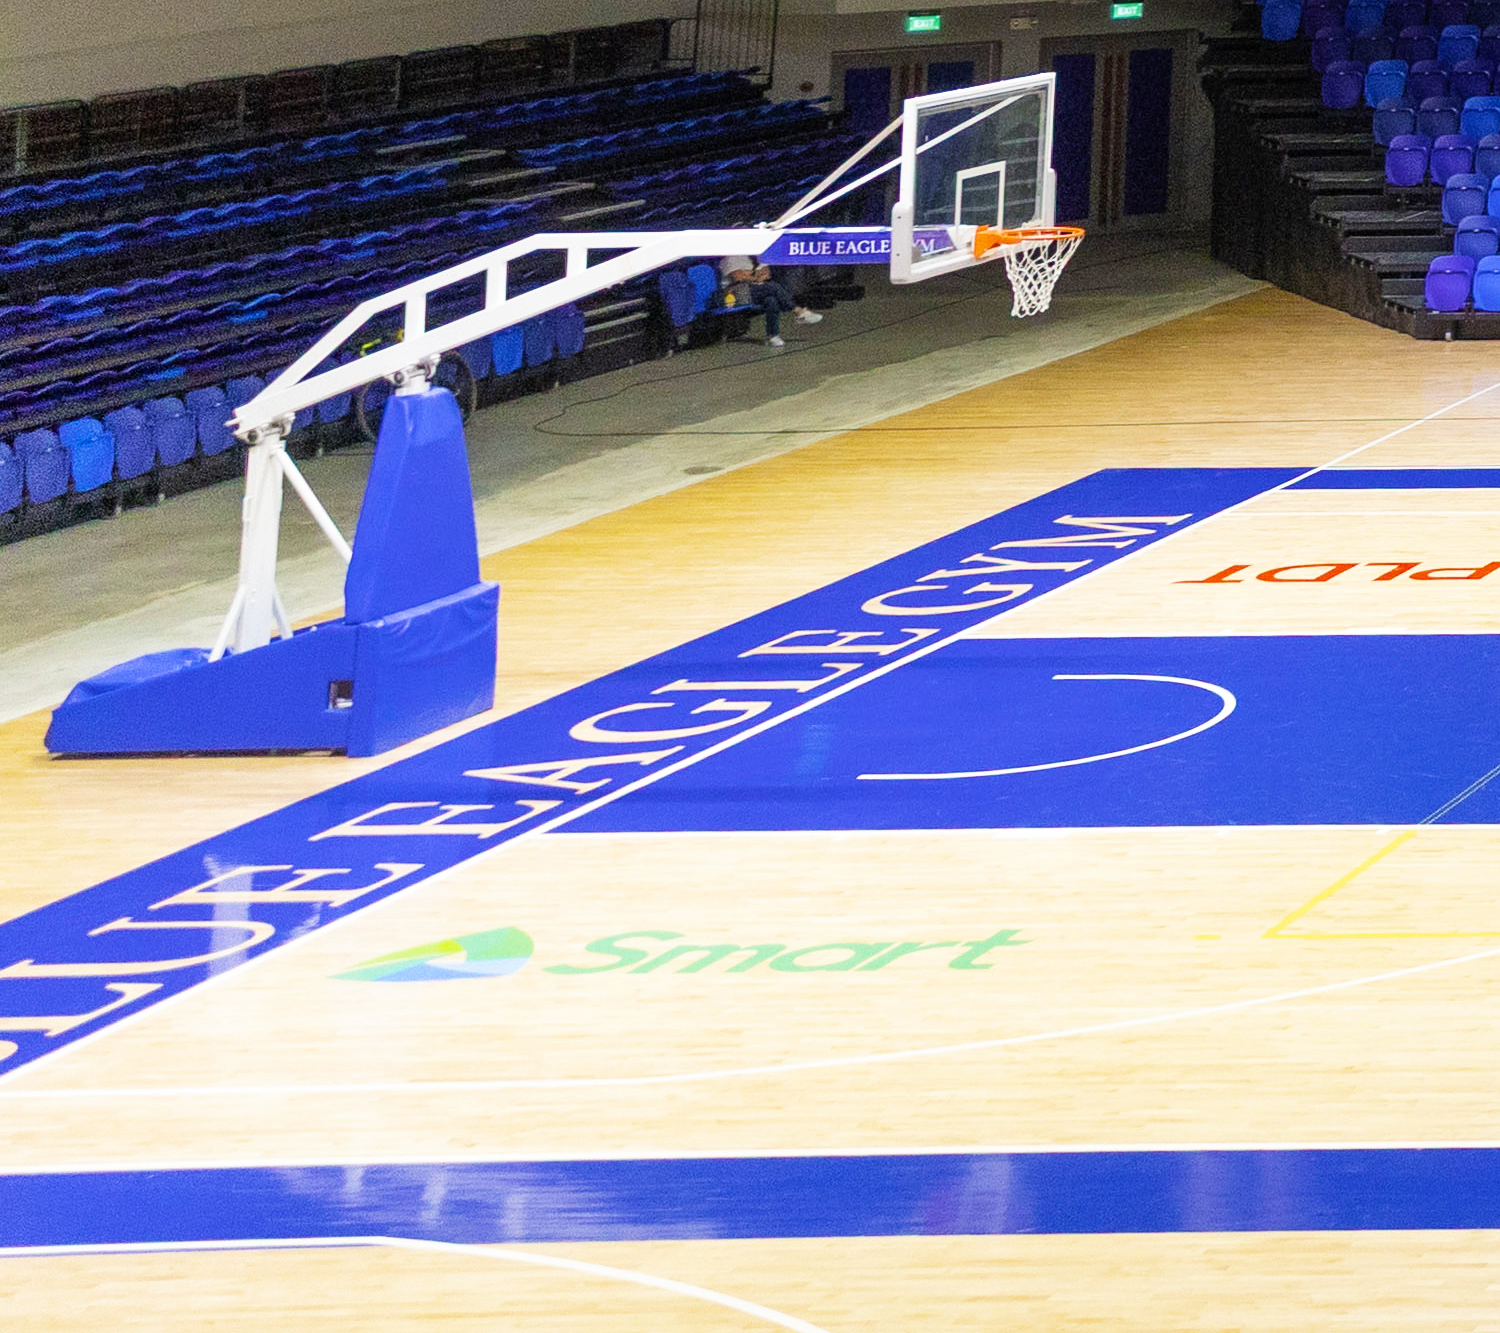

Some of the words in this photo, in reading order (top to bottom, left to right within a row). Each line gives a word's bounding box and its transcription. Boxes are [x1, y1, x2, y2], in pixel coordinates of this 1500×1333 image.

[788, 240, 832, 255] BLUE
[835, 239, 891, 255] EAGLE
[0, 862, 427, 1064] LUE
[308, 626, 940, 841] EAGLE
[860, 513, 1195, 617] GYM
[542, 928, 1037, 975] Smart
